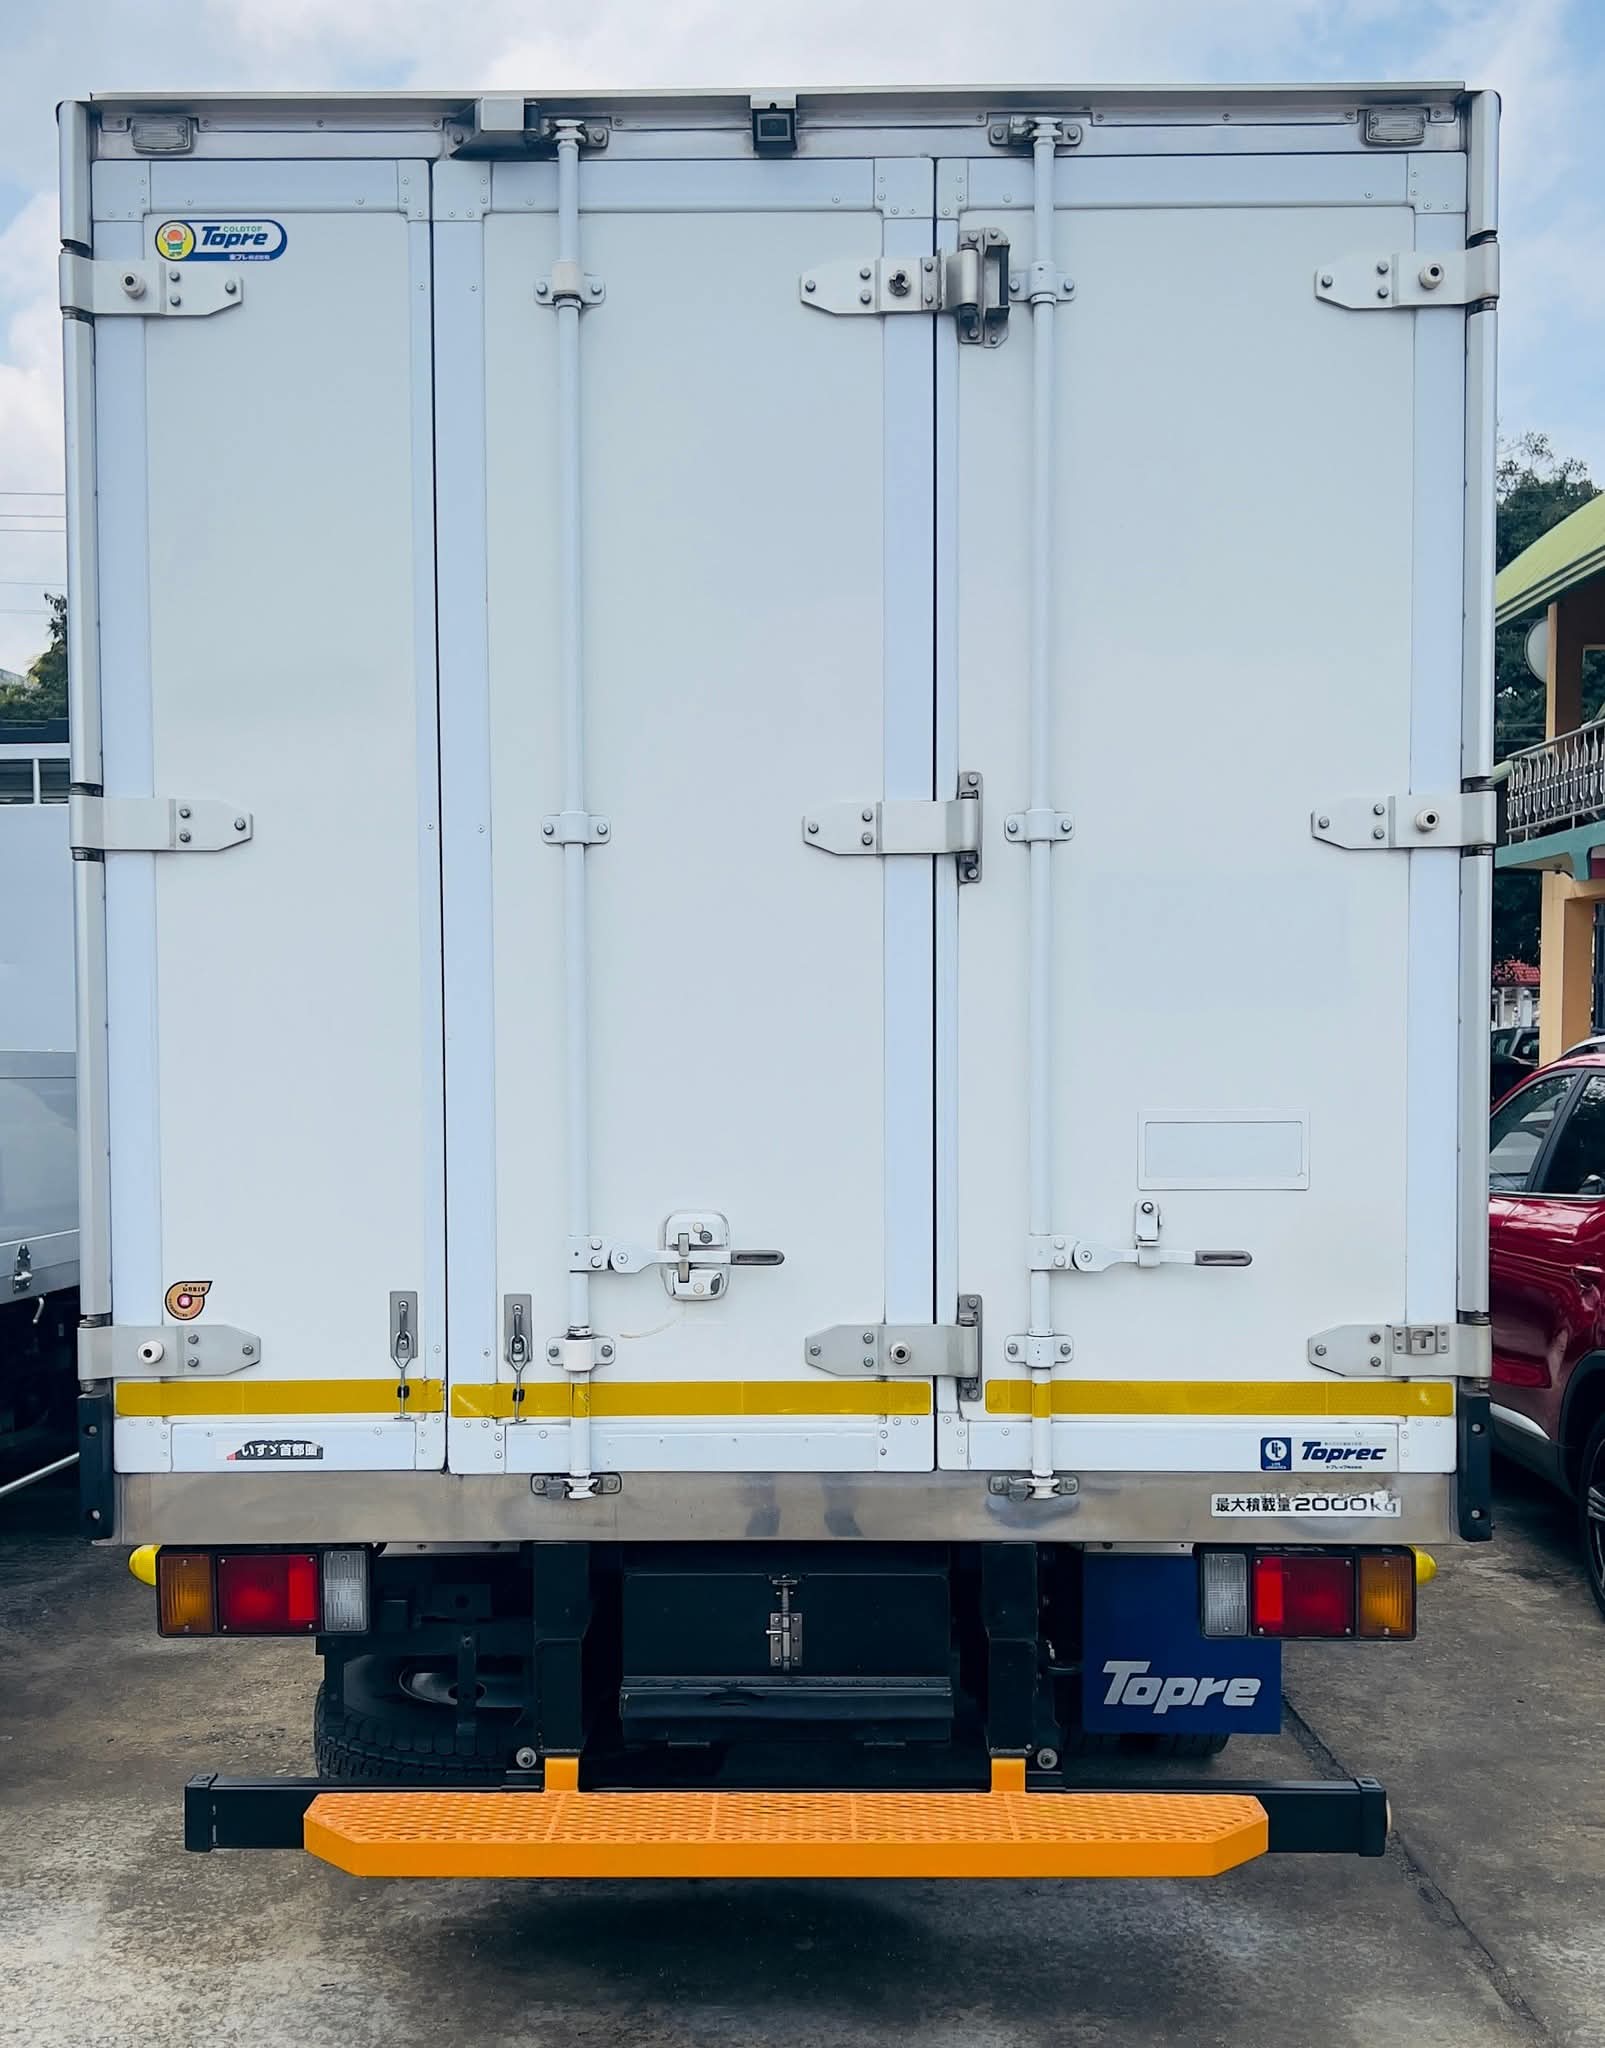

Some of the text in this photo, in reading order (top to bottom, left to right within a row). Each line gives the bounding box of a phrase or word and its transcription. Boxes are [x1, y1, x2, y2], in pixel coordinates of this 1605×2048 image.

[202, 226, 268, 248] Topre
[1302, 1441, 1387, 1463] Toprec
[1102, 1660, 1262, 1714] Topre
